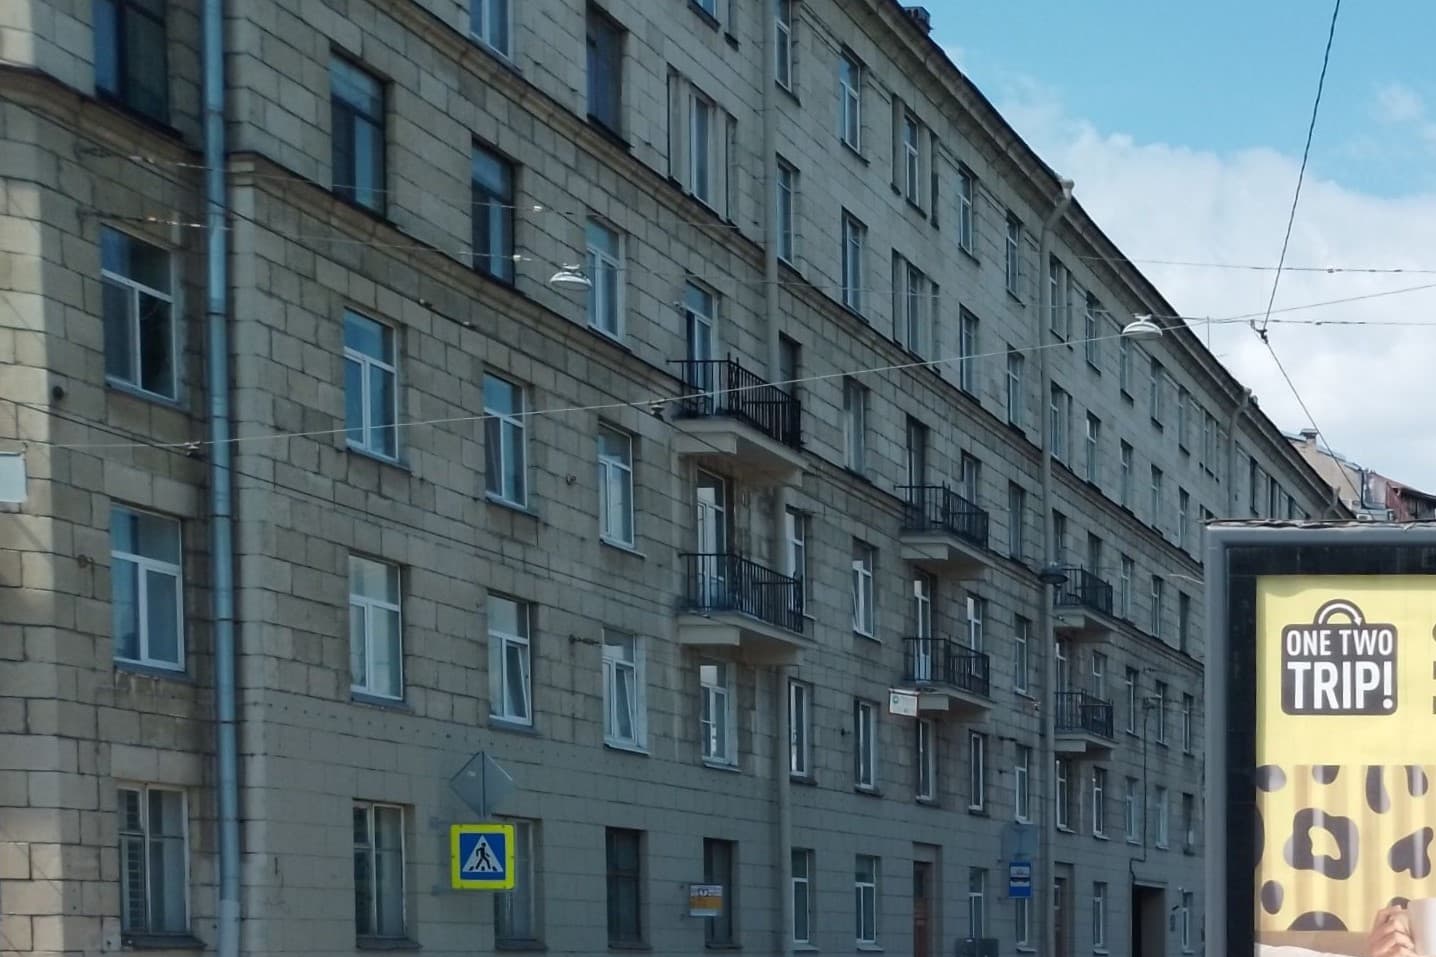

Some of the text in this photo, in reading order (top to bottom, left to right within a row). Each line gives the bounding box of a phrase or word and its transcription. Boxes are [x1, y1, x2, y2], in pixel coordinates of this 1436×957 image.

[1286, 629, 1393, 656] ONE TWO
[1287, 661, 1393, 709] TRIP!
